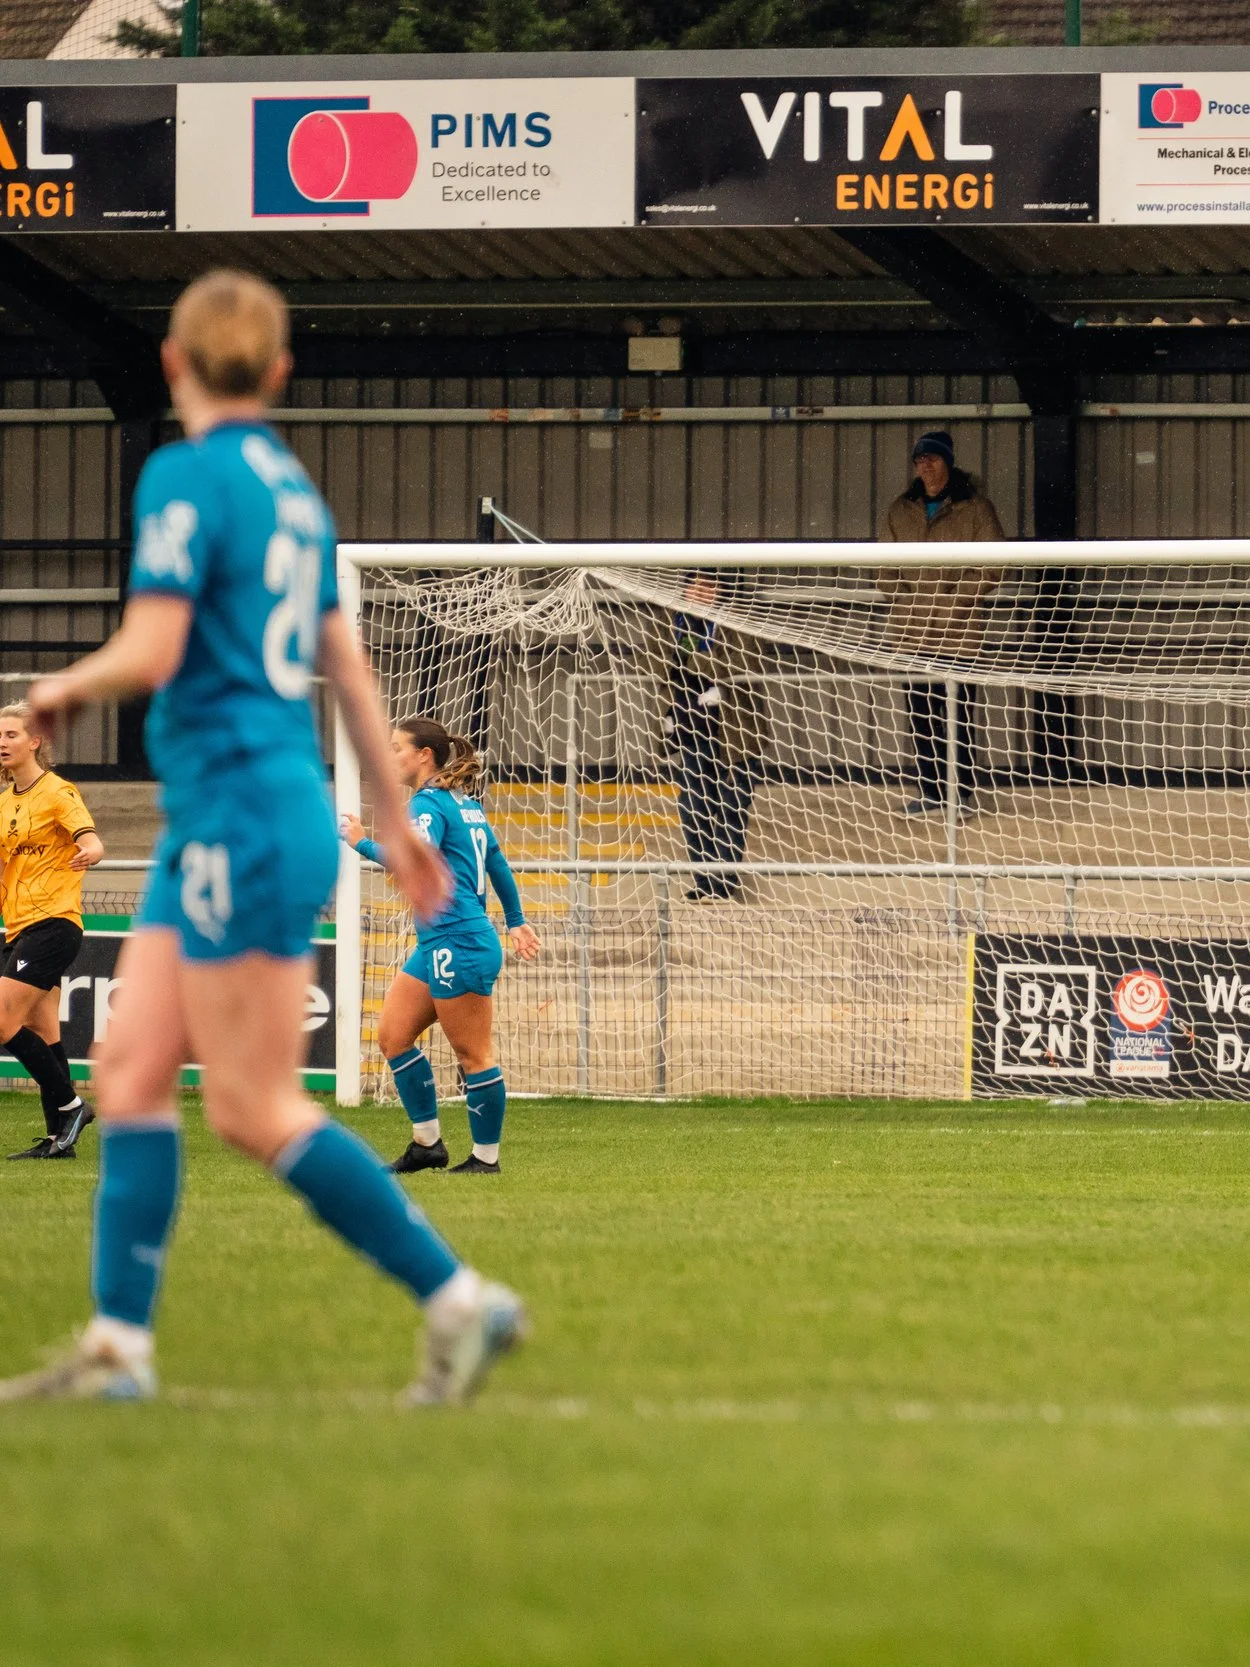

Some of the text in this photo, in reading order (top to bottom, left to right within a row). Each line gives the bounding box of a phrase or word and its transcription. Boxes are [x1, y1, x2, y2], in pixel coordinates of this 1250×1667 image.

[431, 111, 552, 149] PIMS
[740, 90, 994, 162] VITAL
[1157, 147, 1224, 159] Mechanical
[1226, 148, 1236, 158] &
[432, 161, 551, 179] Dedicated to
[0, 182, 74, 217] RGi
[441, 184, 541, 202] Excellence
[433, 948, 455, 979] 12
[1115, 1037, 1165, 1047] NATIONAL
[1116, 1046, 1152, 1057] LEAGUE
